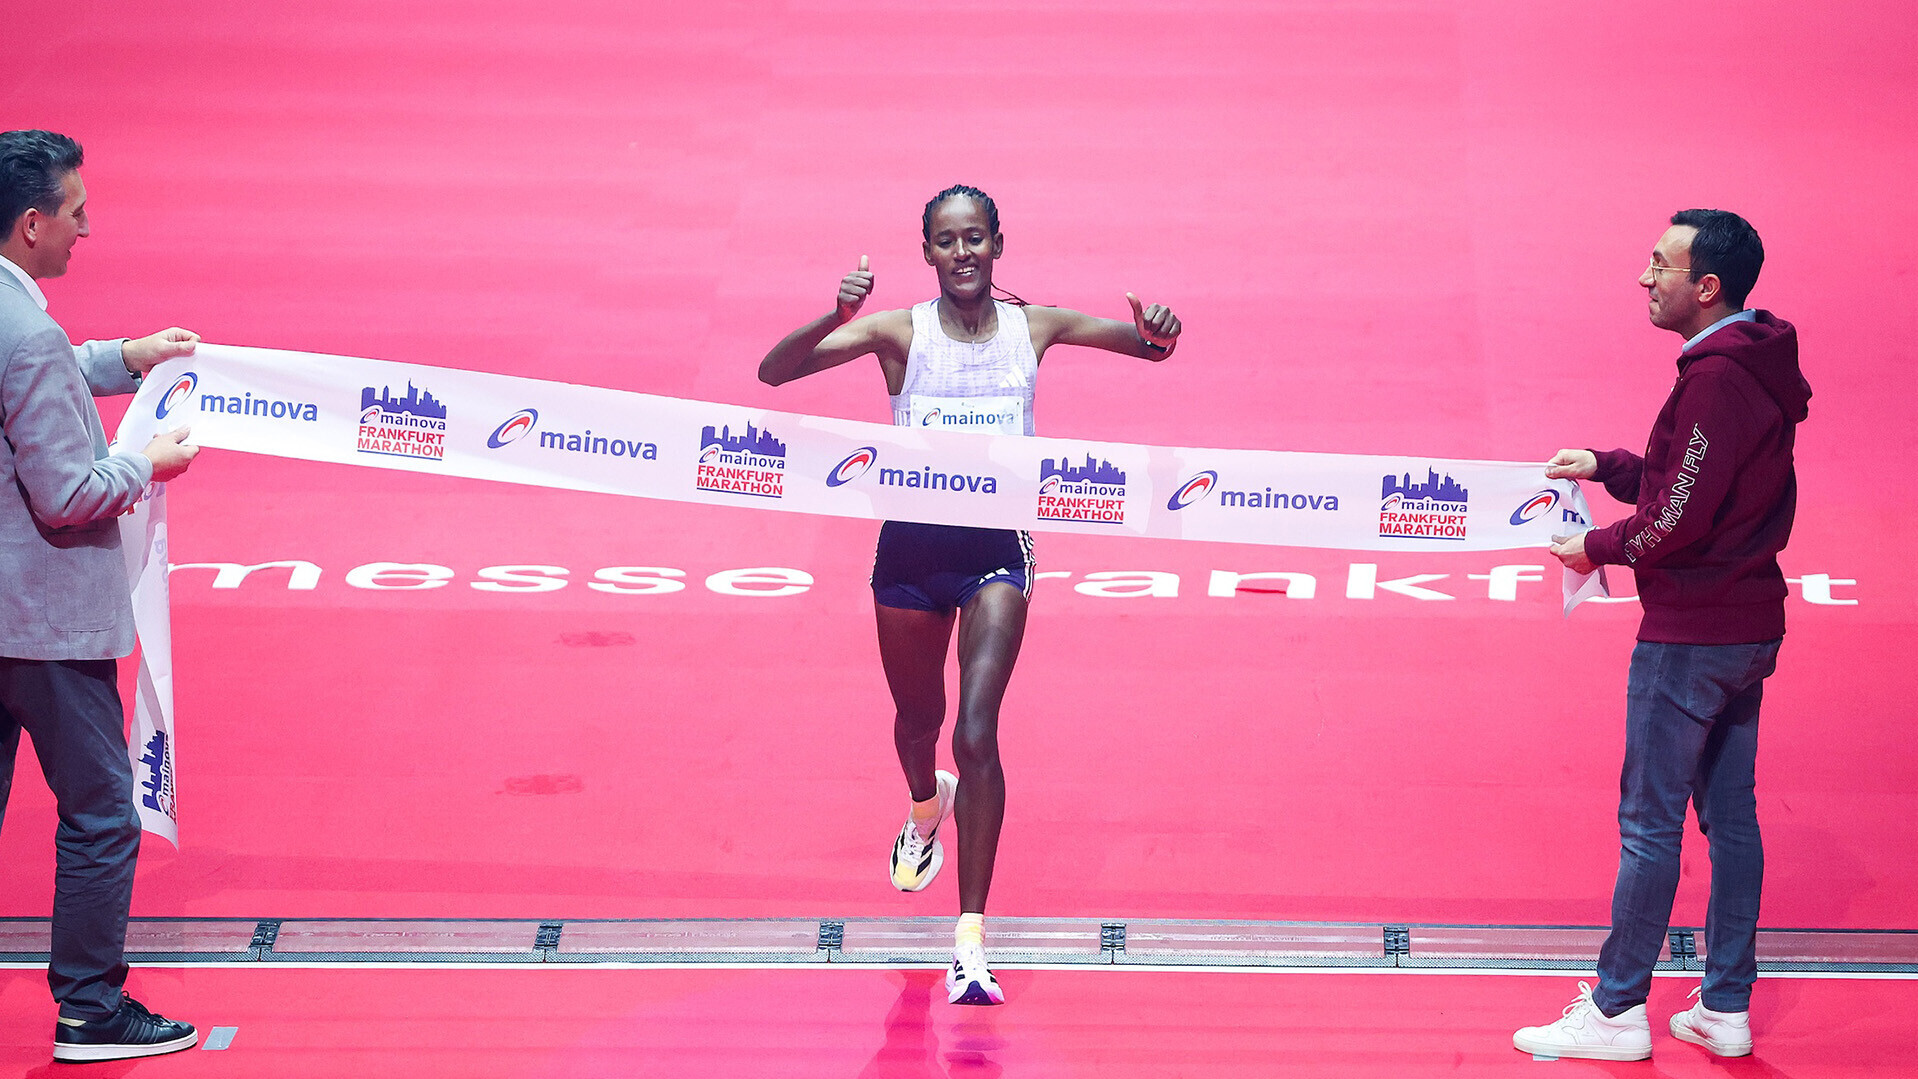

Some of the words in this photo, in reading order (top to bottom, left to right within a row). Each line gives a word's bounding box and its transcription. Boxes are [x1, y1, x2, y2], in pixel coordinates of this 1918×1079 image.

[200, 391, 318, 422] mainova
[380, 412, 447, 431] mainova
[942, 410, 1015, 425] mainova
[358, 425, 445, 445] FRANKFURT
[357, 438, 444, 458] MARATHON
[540, 429, 658, 461] mainova
[1682, 426, 1709, 473] FLY
[719, 451, 786, 470] mainova
[697, 465, 784, 484] FRANKFURT
[879, 465, 997, 494] mainova
[696, 476, 783, 496] MARATHON
[1059, 481, 1126, 497] mainova
[1037, 495, 1125, 511] FRANKFURT
[1220, 486, 1339, 511] mainova
[1401, 498, 1468, 513] mainova
[1037, 506, 1124, 522] MARATHON
[1379, 512, 1467, 526] FRANKFURT
[1379, 522, 1466, 537] MARATHON
[168, 560, 814, 597] messe
